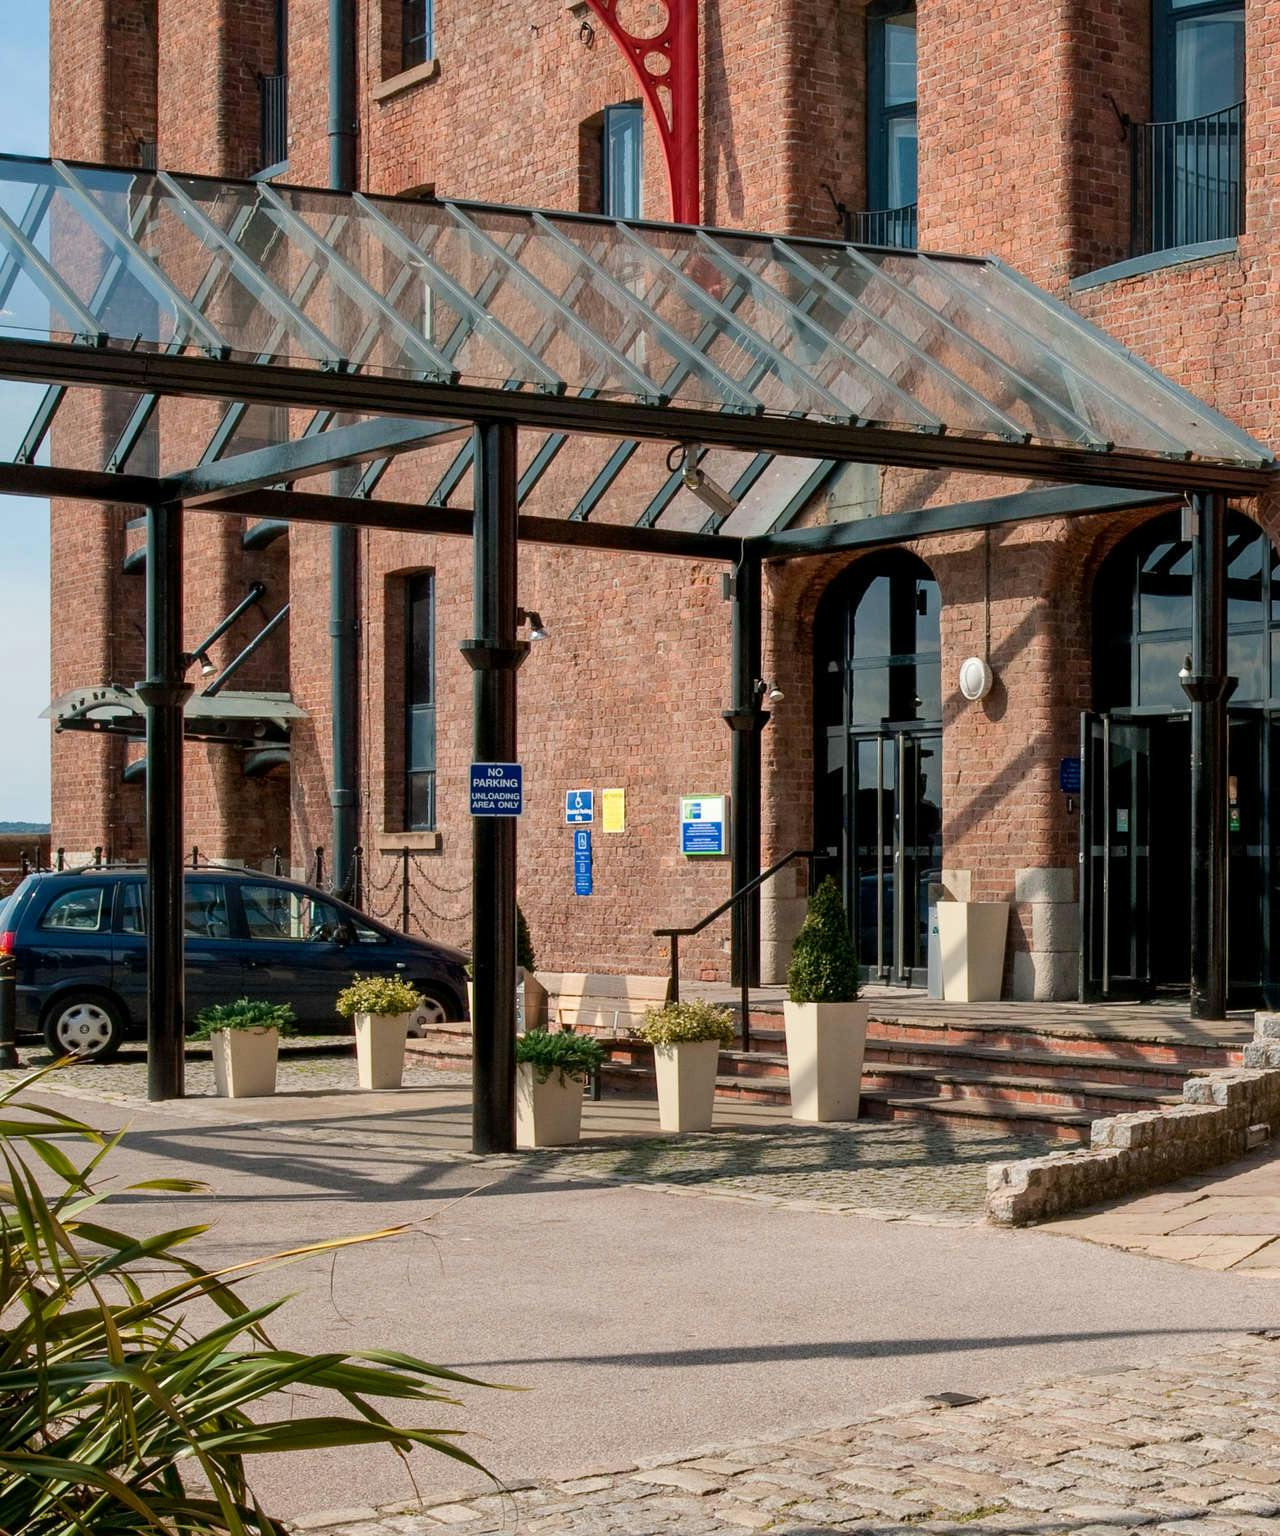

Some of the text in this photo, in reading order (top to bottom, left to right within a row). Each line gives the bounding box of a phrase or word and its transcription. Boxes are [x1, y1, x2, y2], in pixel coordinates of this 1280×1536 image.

[487, 767, 504, 777] NO
[472, 778, 518, 788] PARKING
[471, 792, 520, 800] UNLOADING
[472, 800, 519, 809] AREA ONLY
